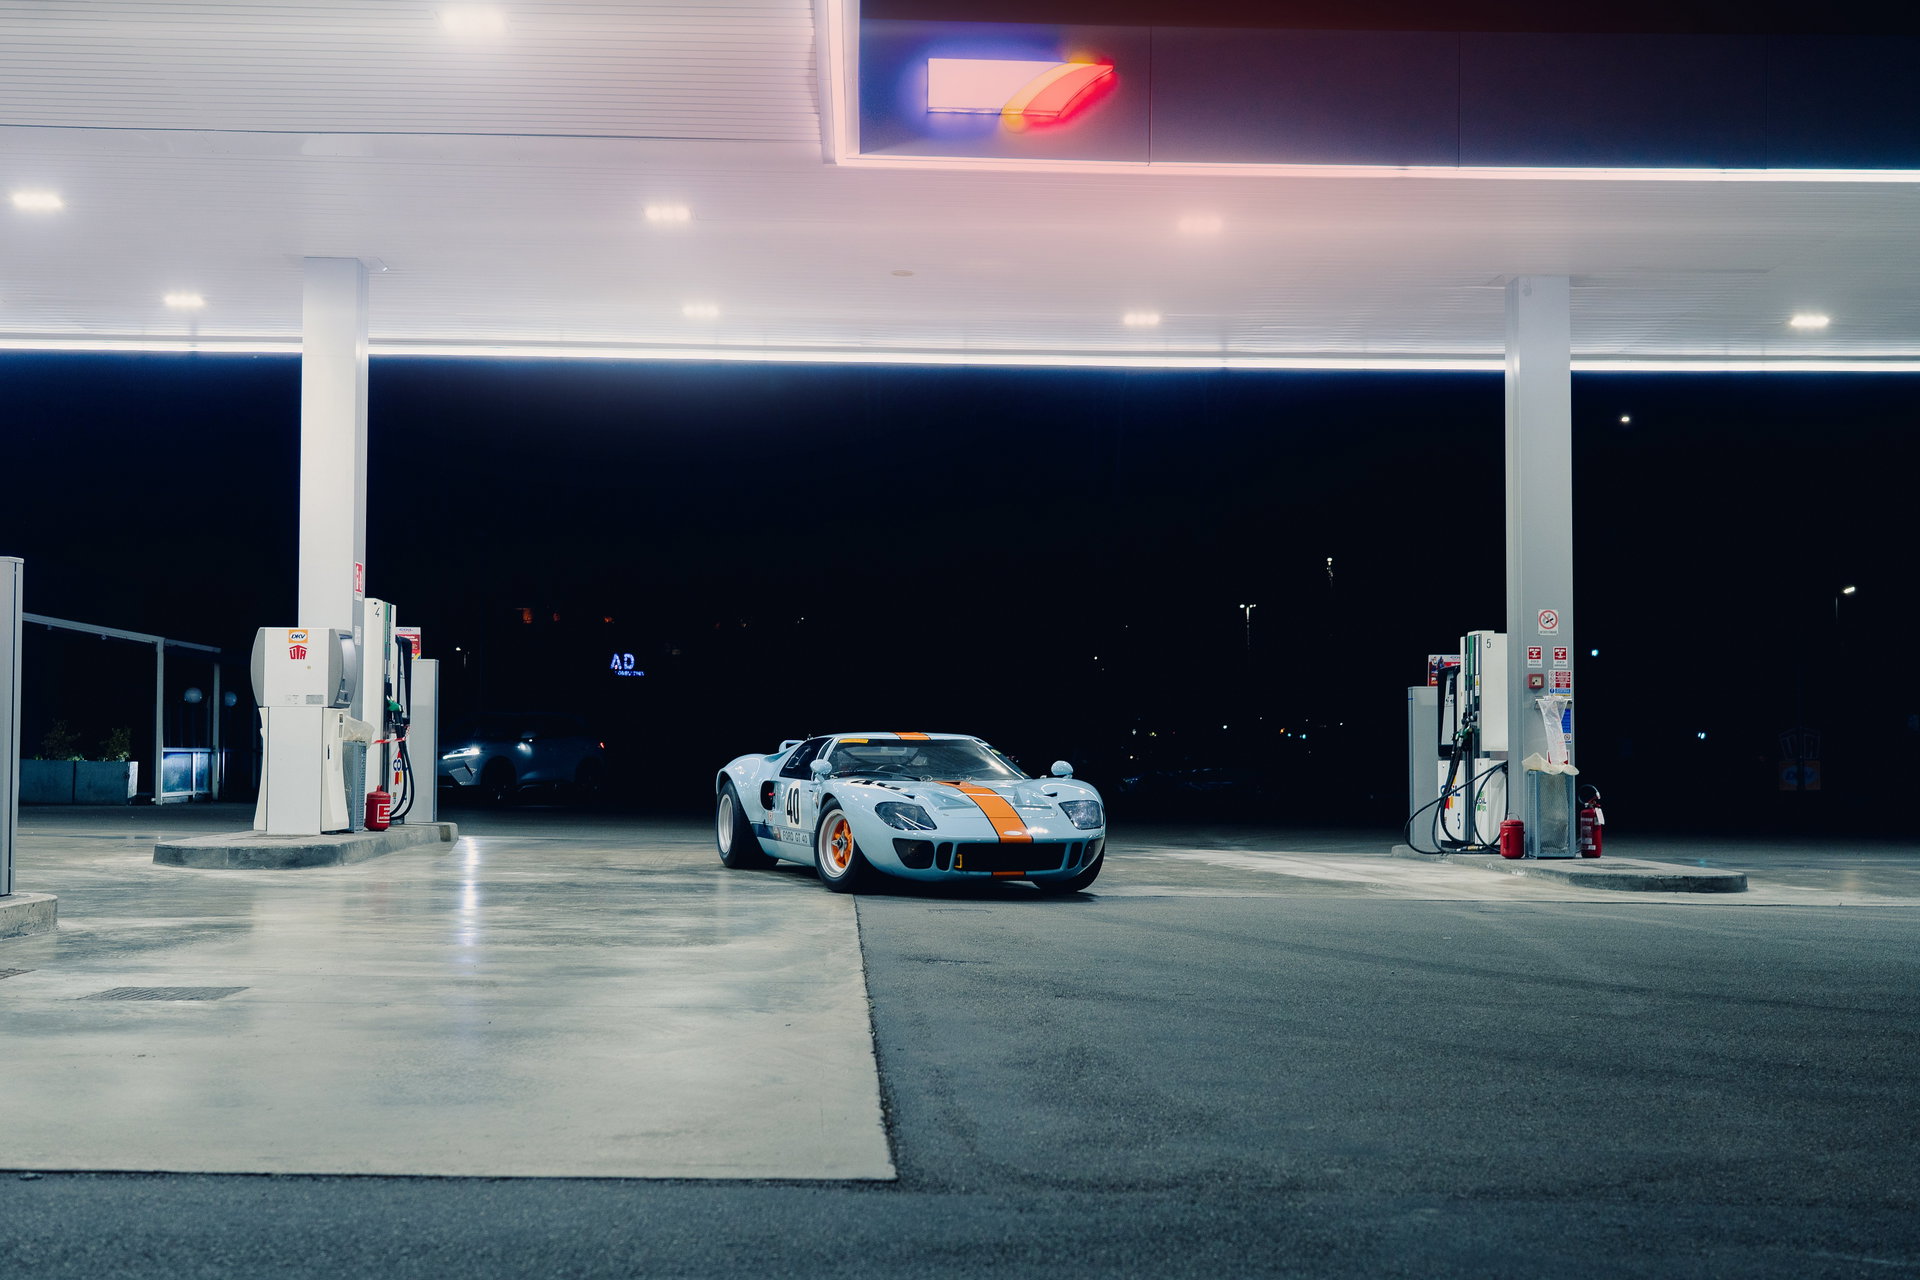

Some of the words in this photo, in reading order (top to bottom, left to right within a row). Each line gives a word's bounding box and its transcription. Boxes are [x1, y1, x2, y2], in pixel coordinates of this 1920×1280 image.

[375, 607, 381, 617] 4
[1486, 638, 1492, 649] 5
[289, 645, 307, 660] UTA
[610, 653, 635, 670] AD
[786, 787, 800, 825] 40
[1457, 812, 1461, 830] 5
[782, 830, 794, 842] FORD
